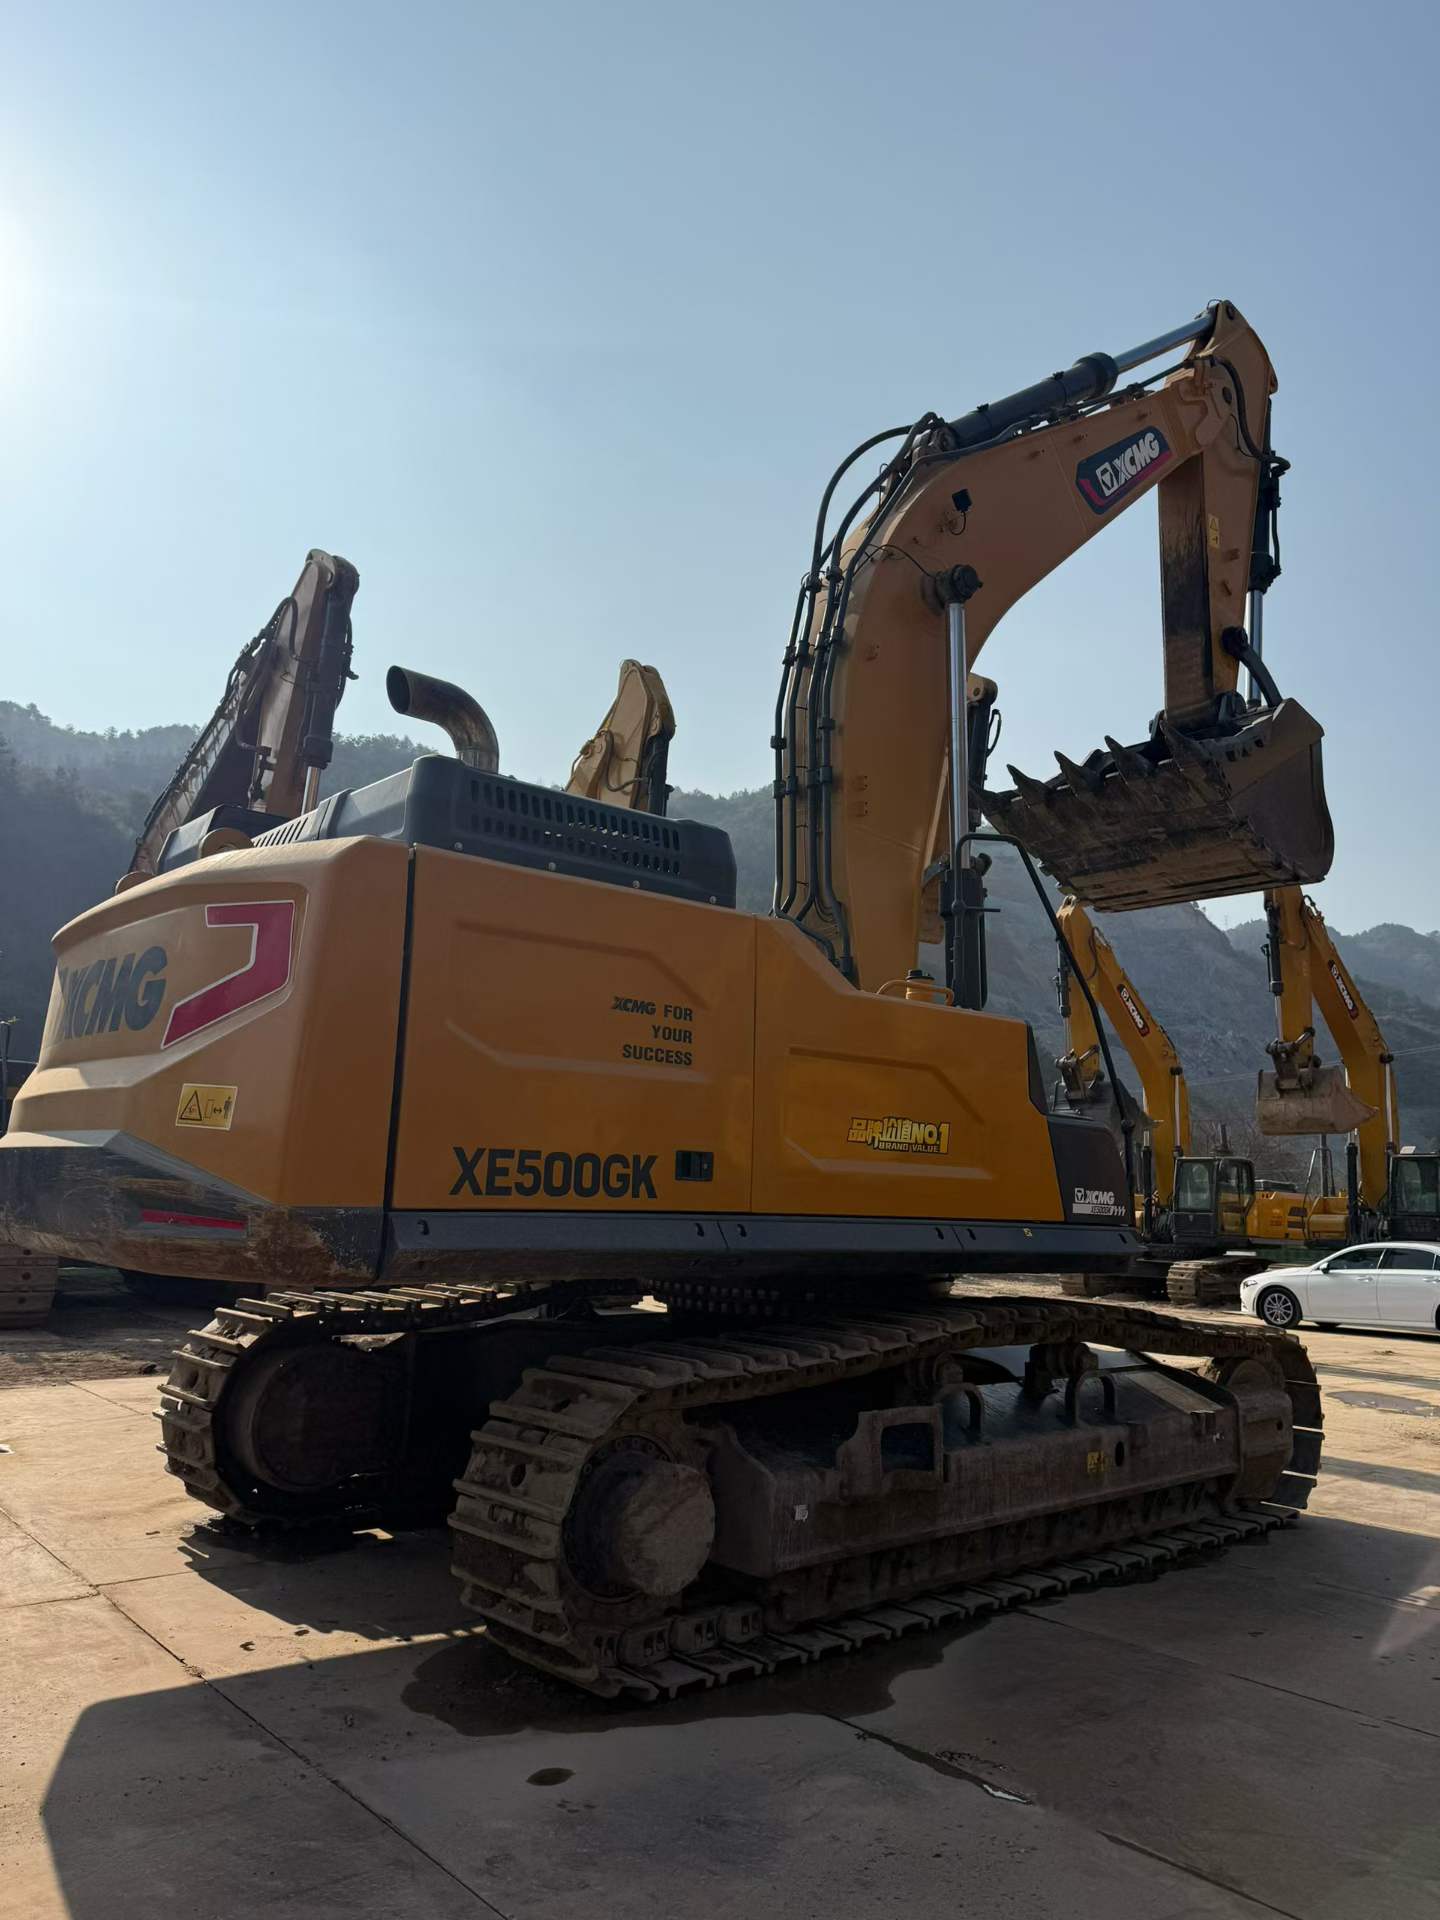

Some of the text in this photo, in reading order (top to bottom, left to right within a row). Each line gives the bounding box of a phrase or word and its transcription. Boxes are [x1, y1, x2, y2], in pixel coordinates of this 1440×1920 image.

[1113, 432, 1160, 485] XCMG
[56, 946, 168, 1040] XCMG
[611, 996, 693, 1021] XCMG FOR
[651, 1024, 693, 1044] YOUR
[622, 1044, 693, 1066] SUCCESS
[878, 1141, 939, 1153] BRAND VALUE
[450, 1146, 659, 1199] XE500GK
[1085, 1190, 1115, 1204] XCMG
